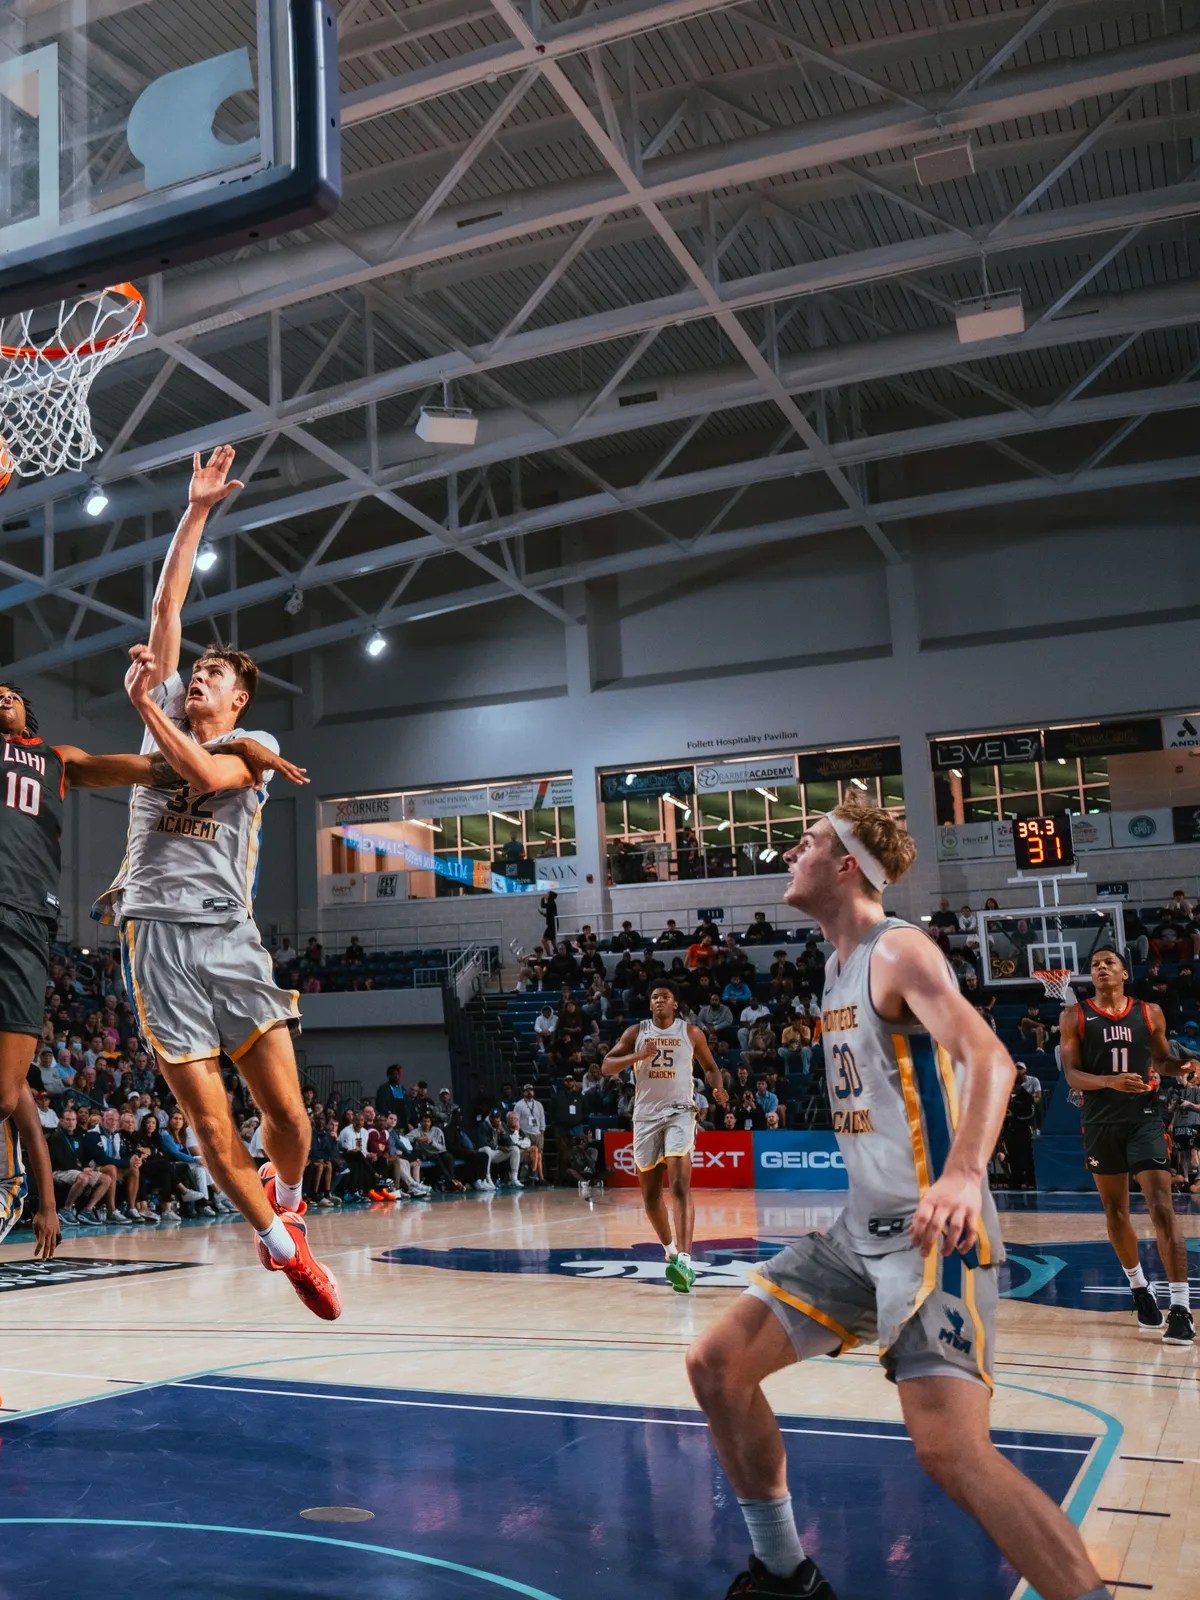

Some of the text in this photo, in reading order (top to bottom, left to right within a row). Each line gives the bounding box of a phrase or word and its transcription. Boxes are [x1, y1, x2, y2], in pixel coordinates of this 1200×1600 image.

[687, 731, 798, 749] Follett Hospitality Pavilion
[3, 743, 46, 776] LUHI
[6, 771, 40, 816] 10
[156, 815, 221, 840] ACADEMY
[1018, 819, 1055, 838] 39.3
[1028, 837, 1062, 864] 31
[381, 876, 395, 886] FLY
[1103, 1026, 1132, 1043] LUHI
[652, 1049, 674, 1067] 25
[1111, 1047, 1128, 1073] 11
[649, 1071, 676, 1079] ACADEMY
[832, 1042, 863, 1100] 30
[690, 1151, 745, 1168] EXT
